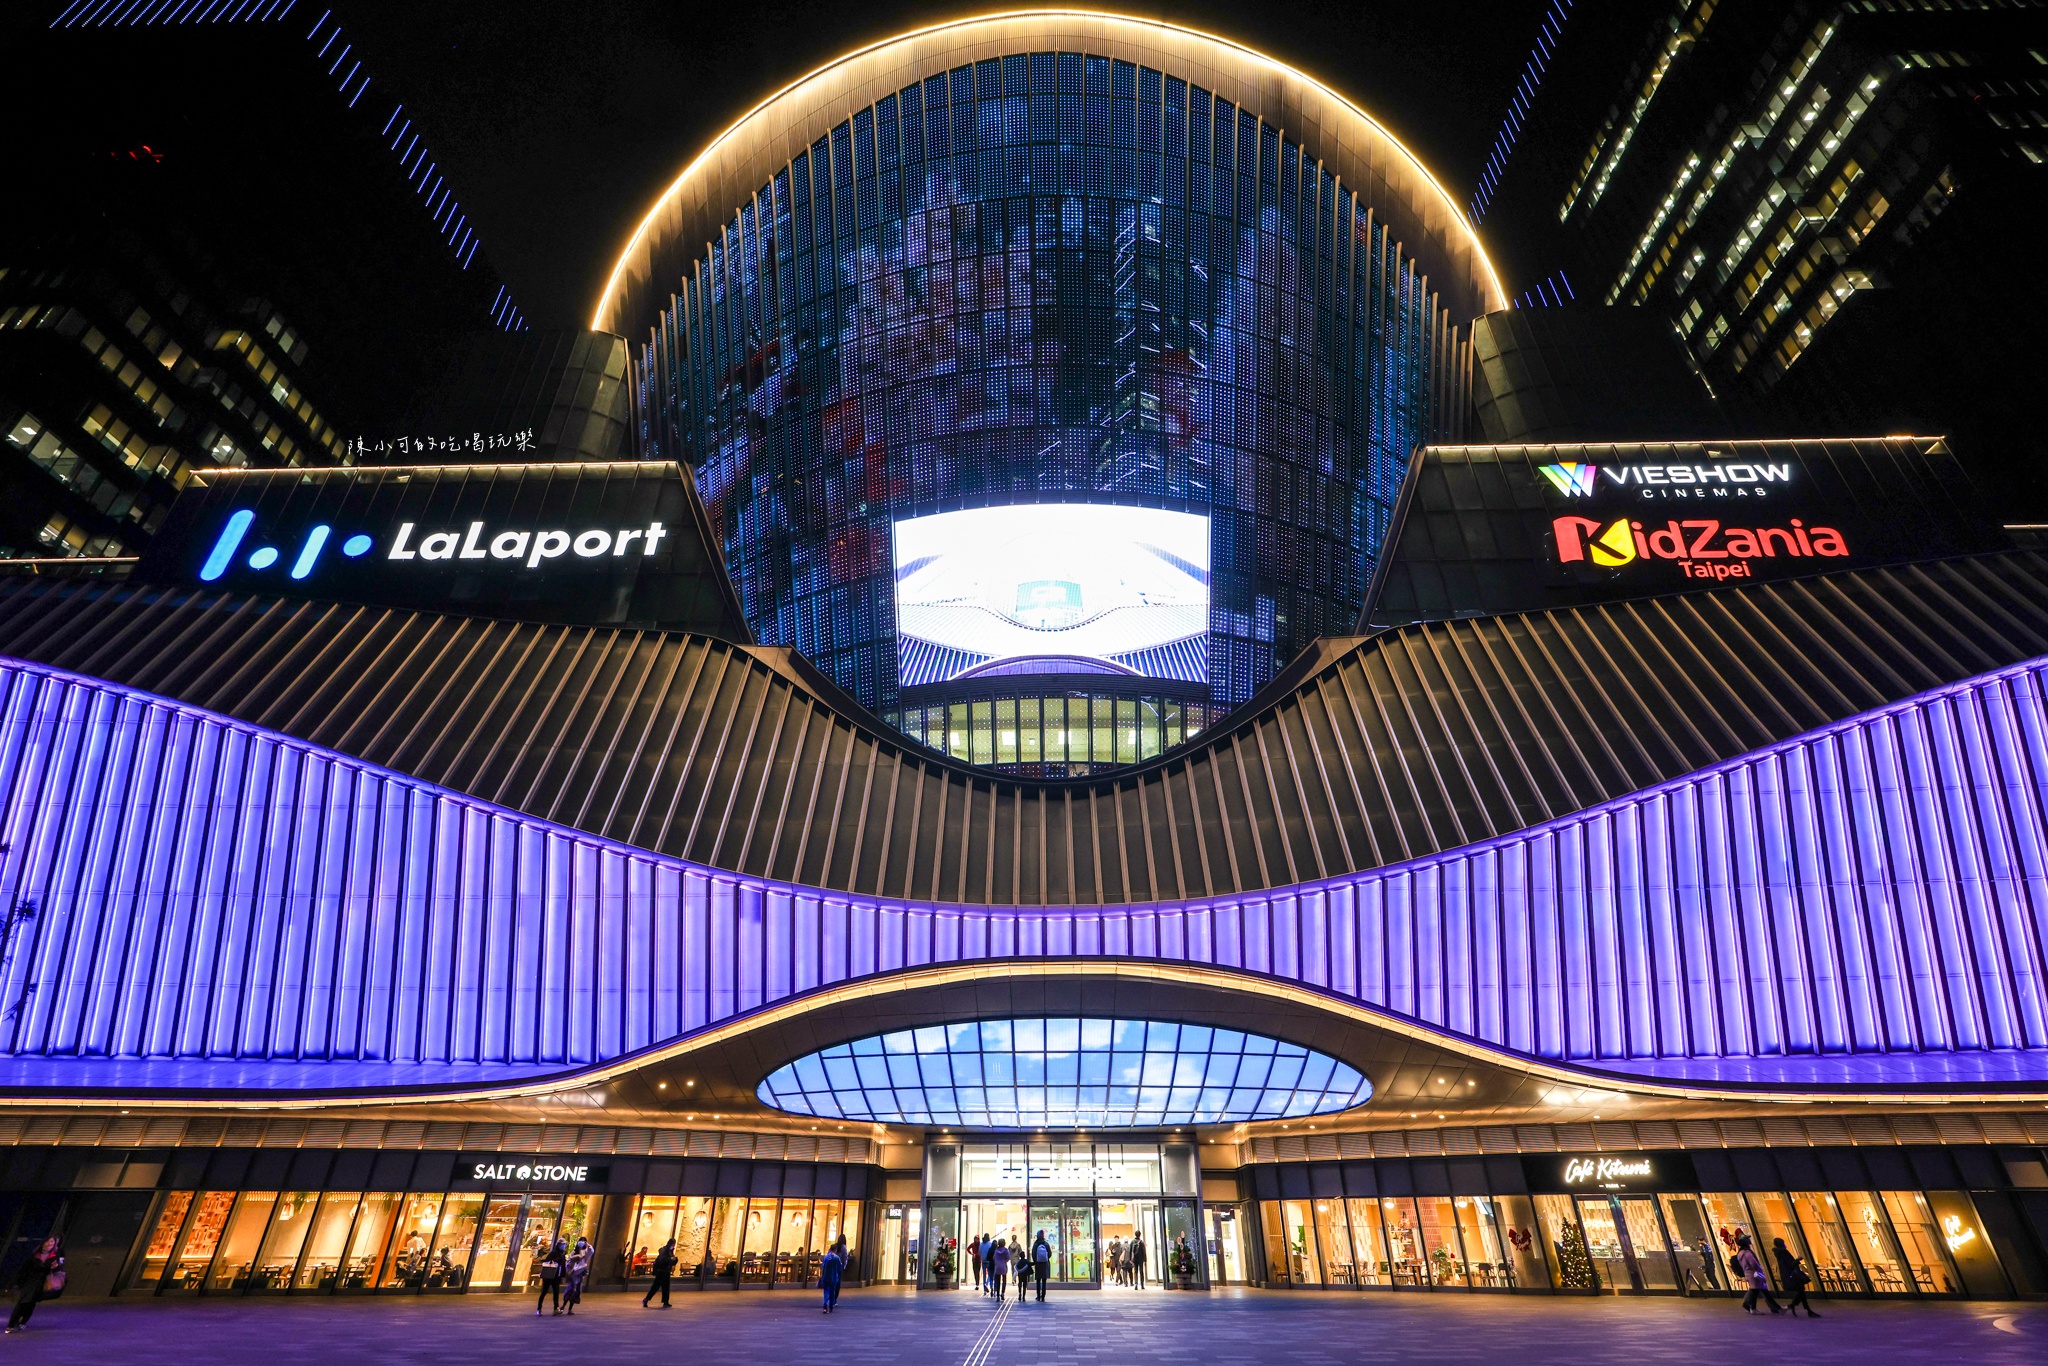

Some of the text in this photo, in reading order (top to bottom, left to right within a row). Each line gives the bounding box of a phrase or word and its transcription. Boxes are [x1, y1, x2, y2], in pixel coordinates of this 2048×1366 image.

[1602, 464, 1790, 485] VIESHOW
[1642, 487, 1767, 499] CINEMAS
[387, 521, 667, 568] LaLaport
[1553, 516, 1849, 567] KidZania
[1678, 560, 1751, 581] Taipei
[473, 1163, 588, 1181] SALT STONE
[1565, 1158, 1595, 1183] Café
